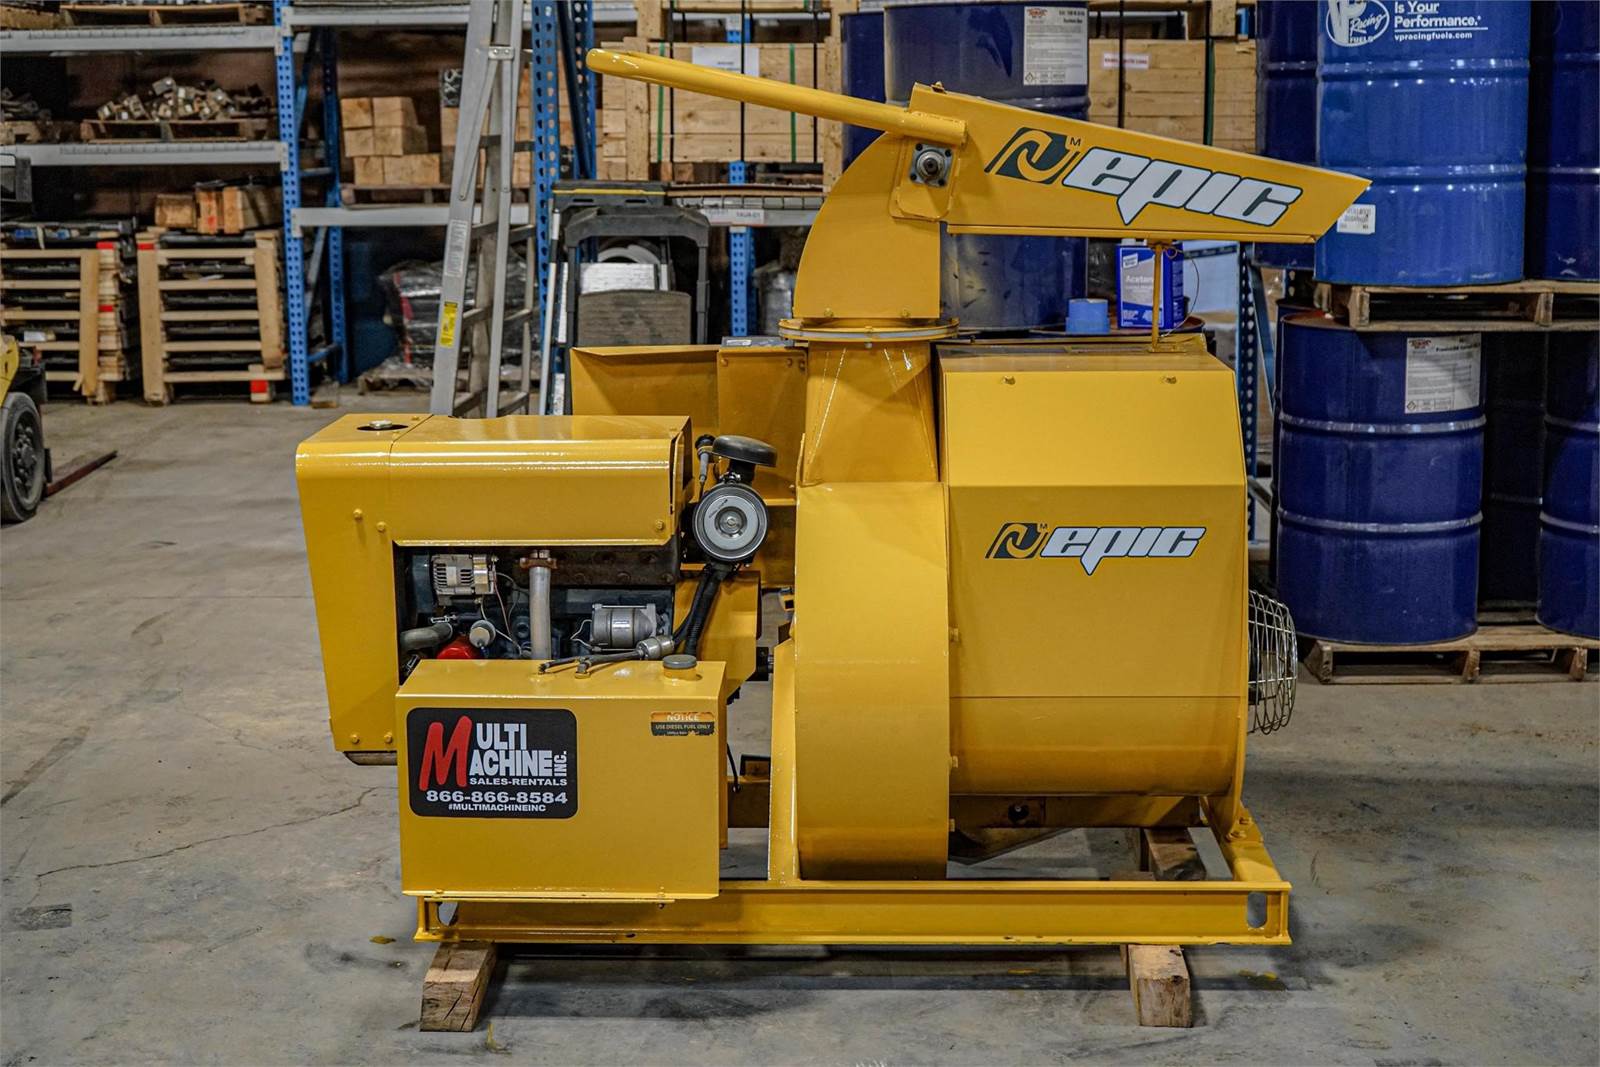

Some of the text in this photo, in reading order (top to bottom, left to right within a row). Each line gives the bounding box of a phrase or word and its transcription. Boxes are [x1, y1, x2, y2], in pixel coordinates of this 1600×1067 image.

[1394, 1, 1440, 14] Is Your
[469, 777, 568, 786] SALES-RENTALS
[426, 790, 568, 804] 866-866-8584
[448, 803, 547, 812] #MULTIMACHINEINC
